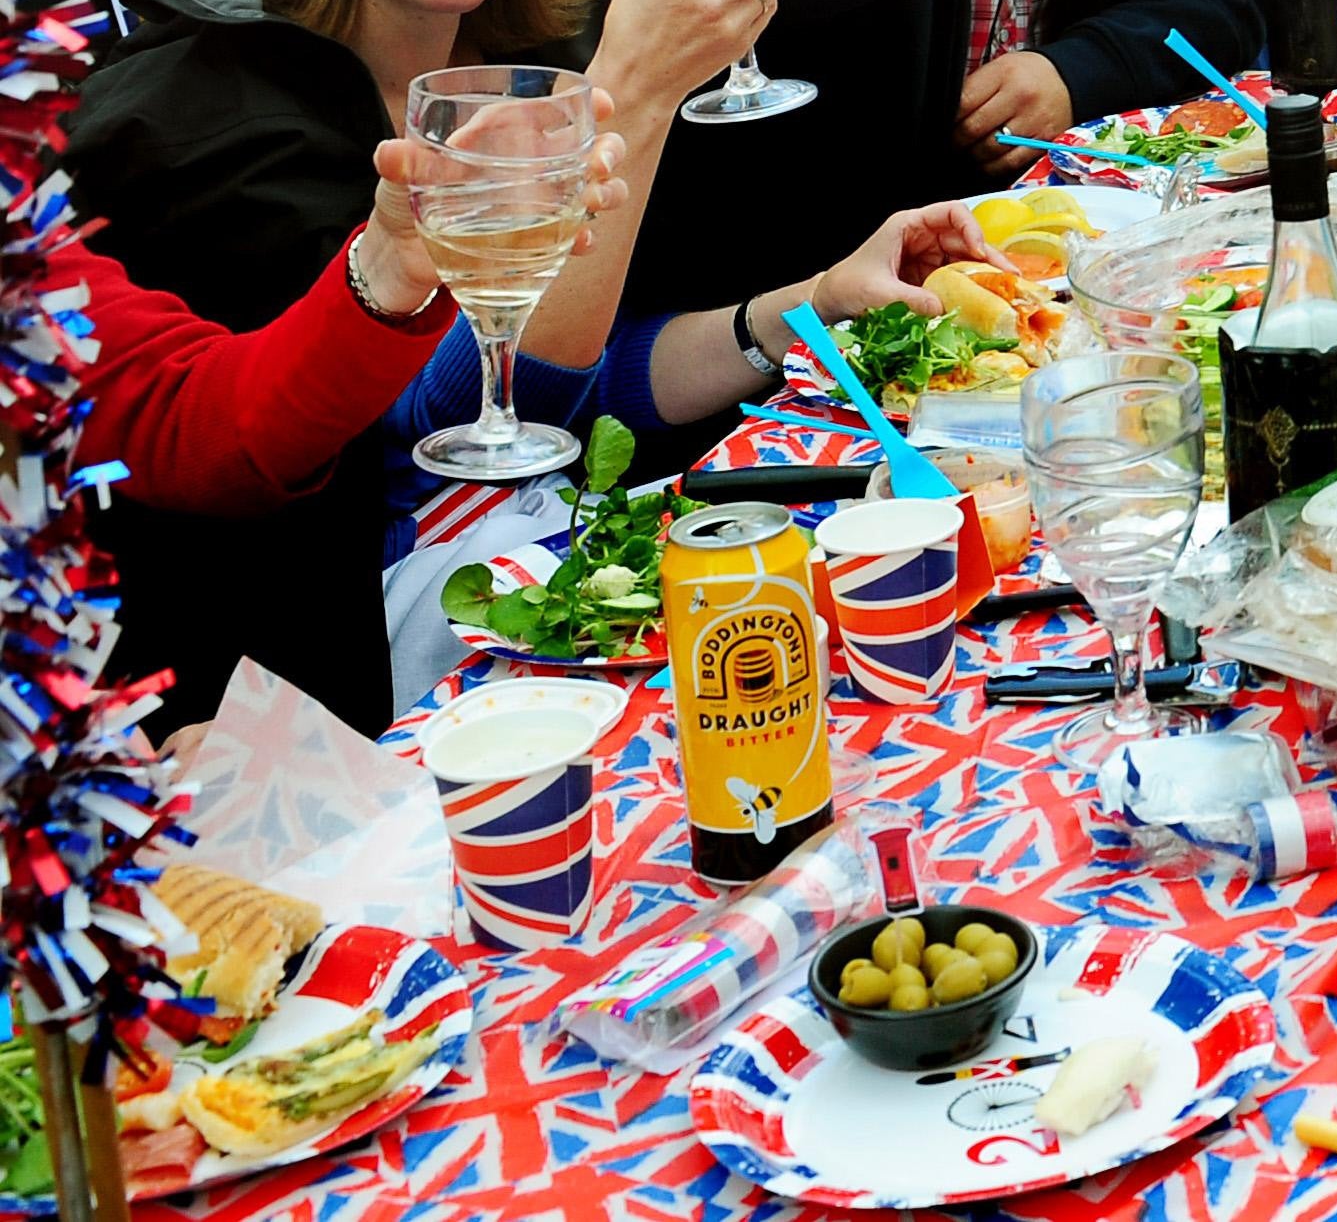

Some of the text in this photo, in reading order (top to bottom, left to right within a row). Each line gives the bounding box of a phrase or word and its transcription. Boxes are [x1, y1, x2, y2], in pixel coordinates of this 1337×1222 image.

[701, 615, 802, 680] BODDINGTONS
[699, 692, 813, 731] DRAUGHT
[726, 725, 796, 747] BITTER
